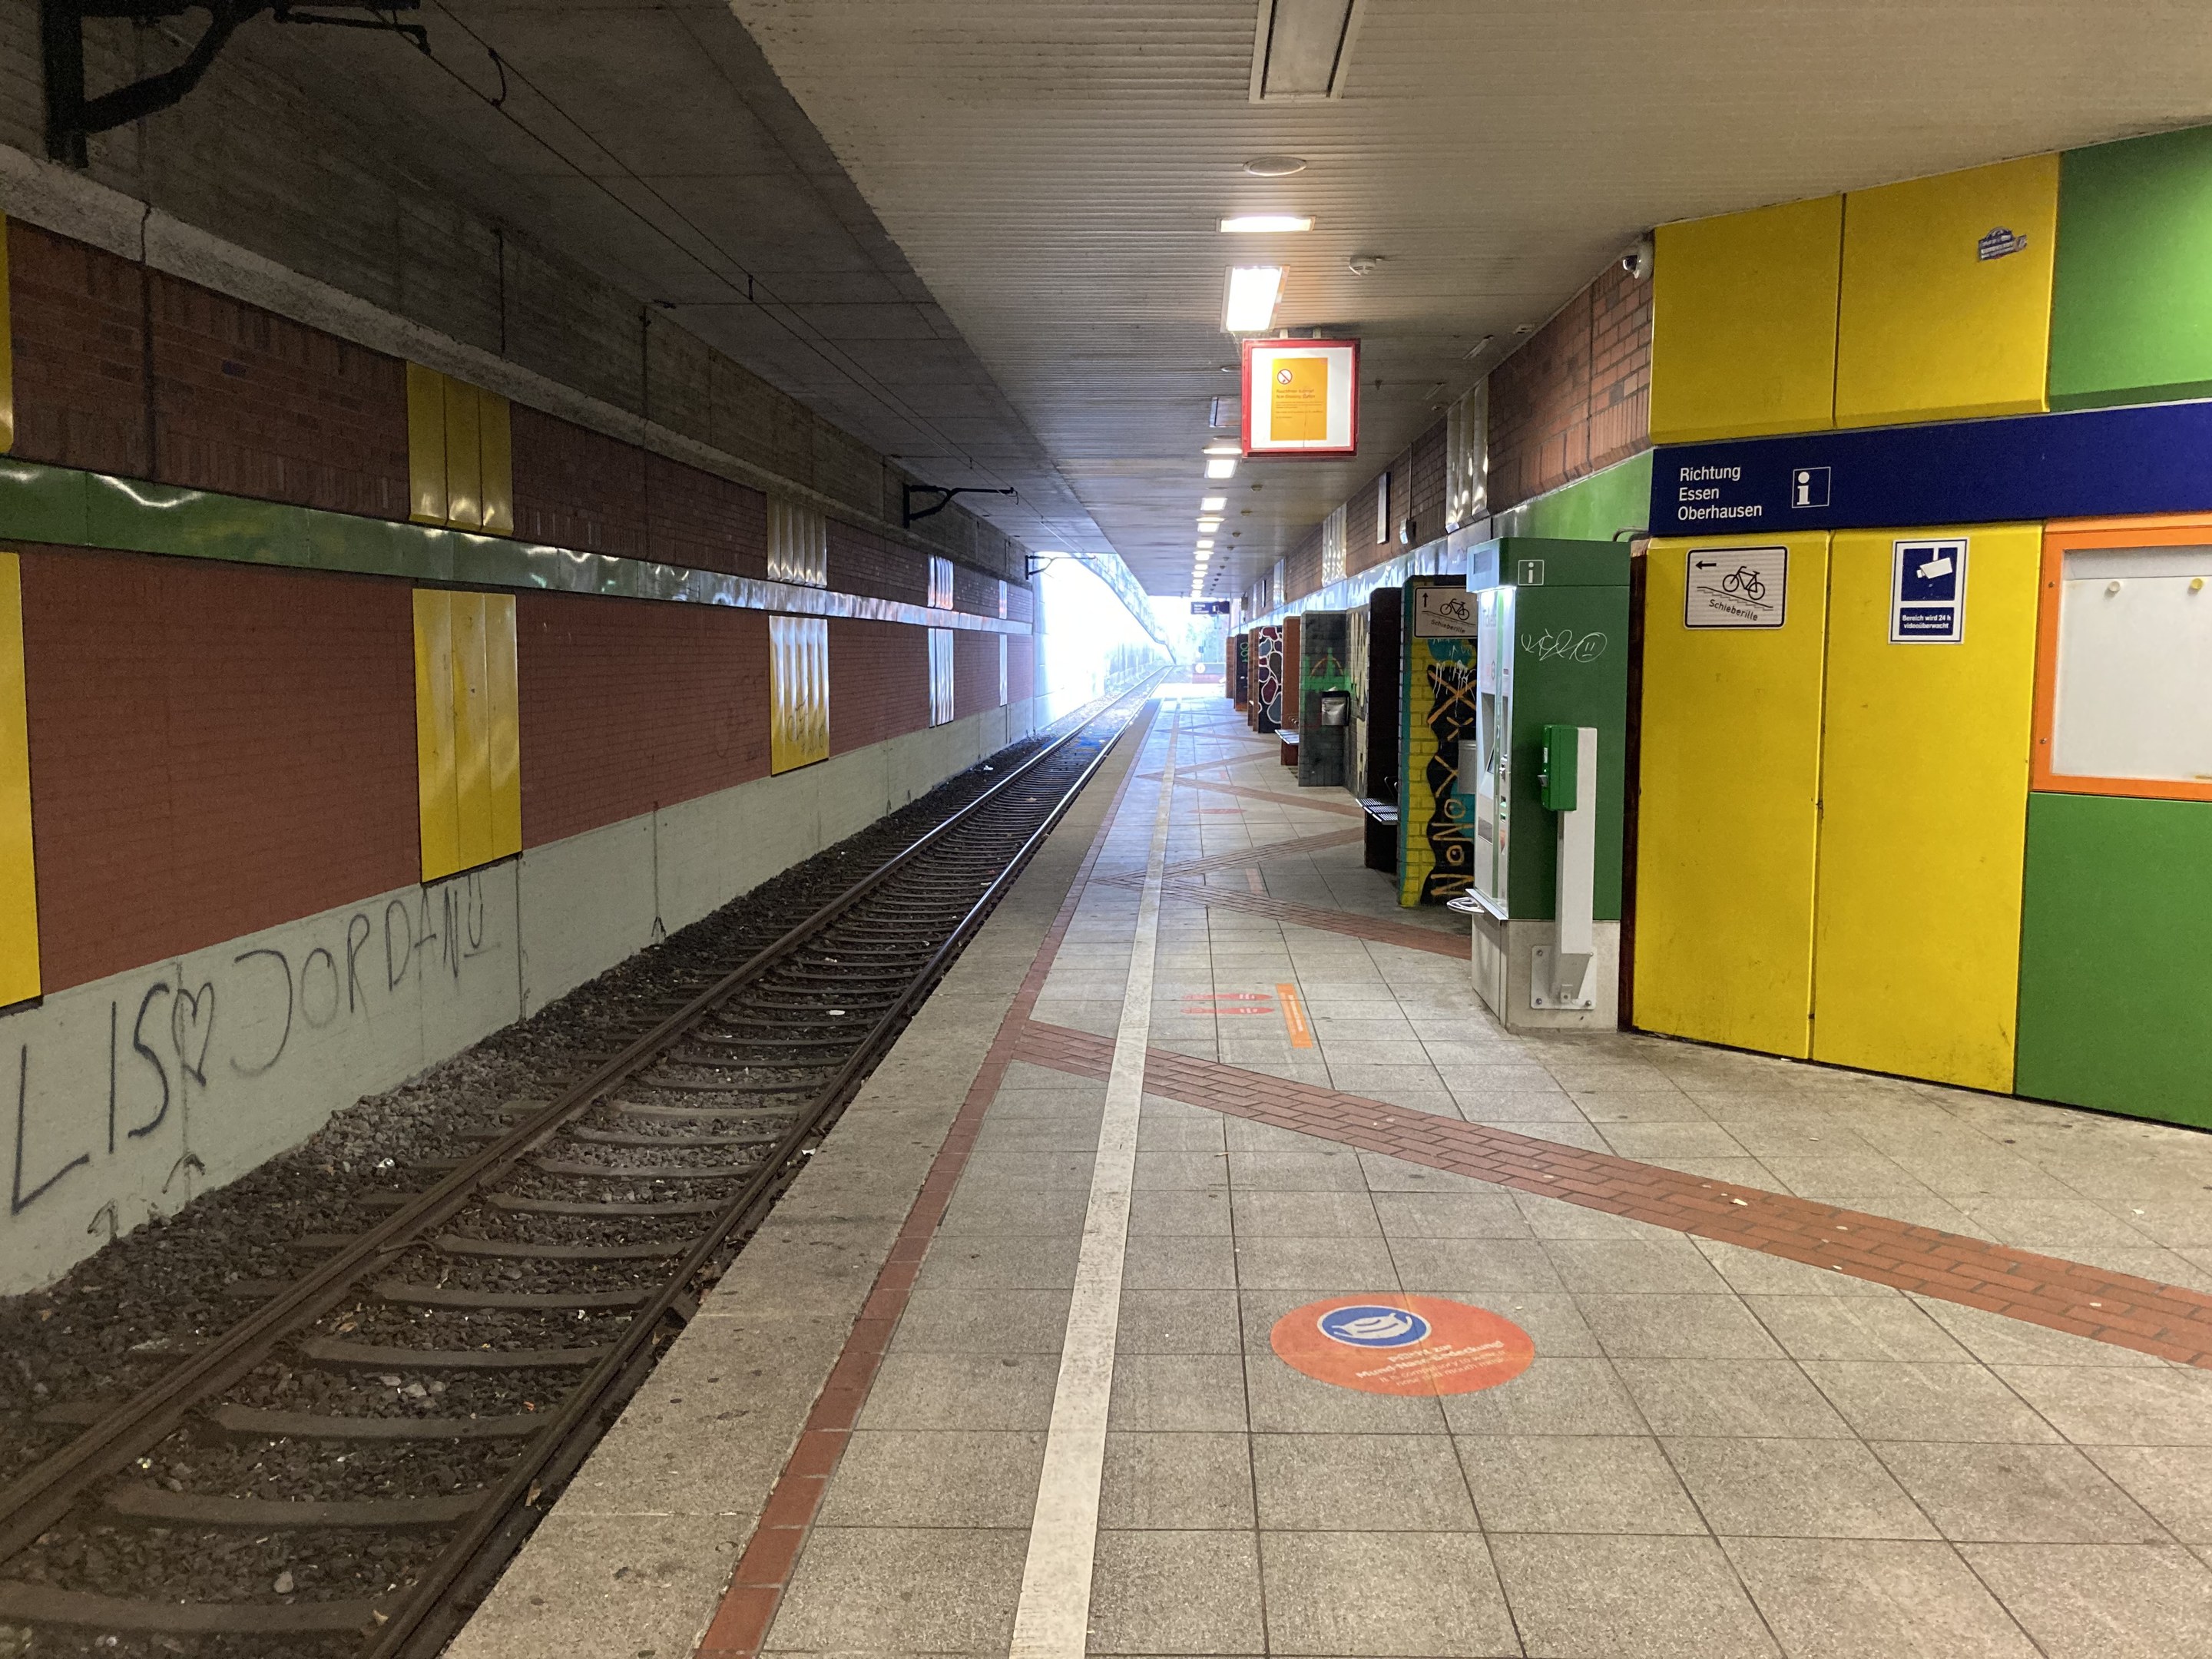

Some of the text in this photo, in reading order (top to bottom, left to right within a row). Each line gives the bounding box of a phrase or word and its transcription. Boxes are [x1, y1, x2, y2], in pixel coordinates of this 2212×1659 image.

[1680, 466, 1741, 482] Richtung
[1678, 487, 1720, 502] Essen
[1677, 505, 1763, 521] Oberhausen
[1708, 598, 1759, 621] Schieberille
